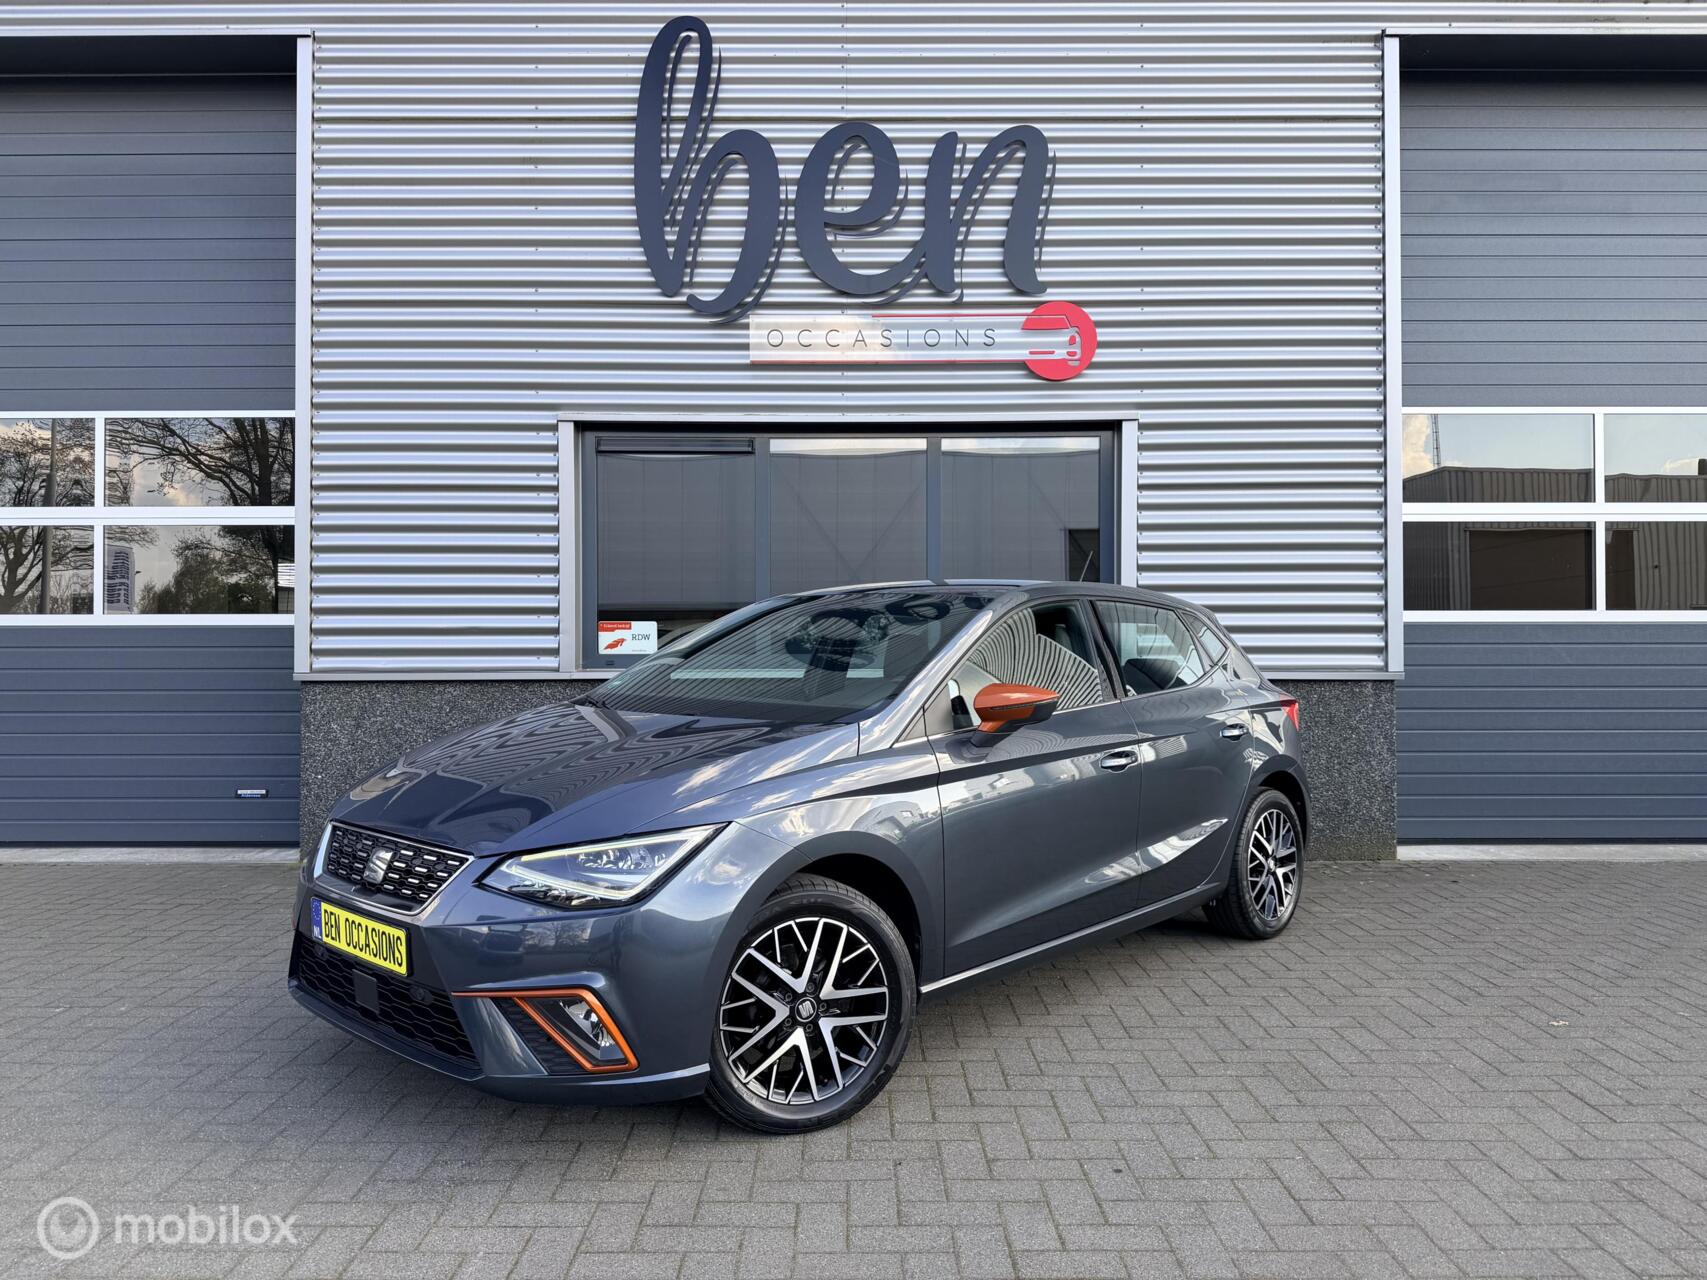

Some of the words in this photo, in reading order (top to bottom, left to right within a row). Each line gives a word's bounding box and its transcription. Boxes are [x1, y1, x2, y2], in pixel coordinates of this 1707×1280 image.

[634, 16, 1048, 315] ben
[766, 327, 997, 349] OCCASIONS
[631, 633, 651, 641] RDW
[313, 925, 322, 939] NL
[323, 909, 341, 943] BEN
[344, 917, 403, 967] OCCASIONS
